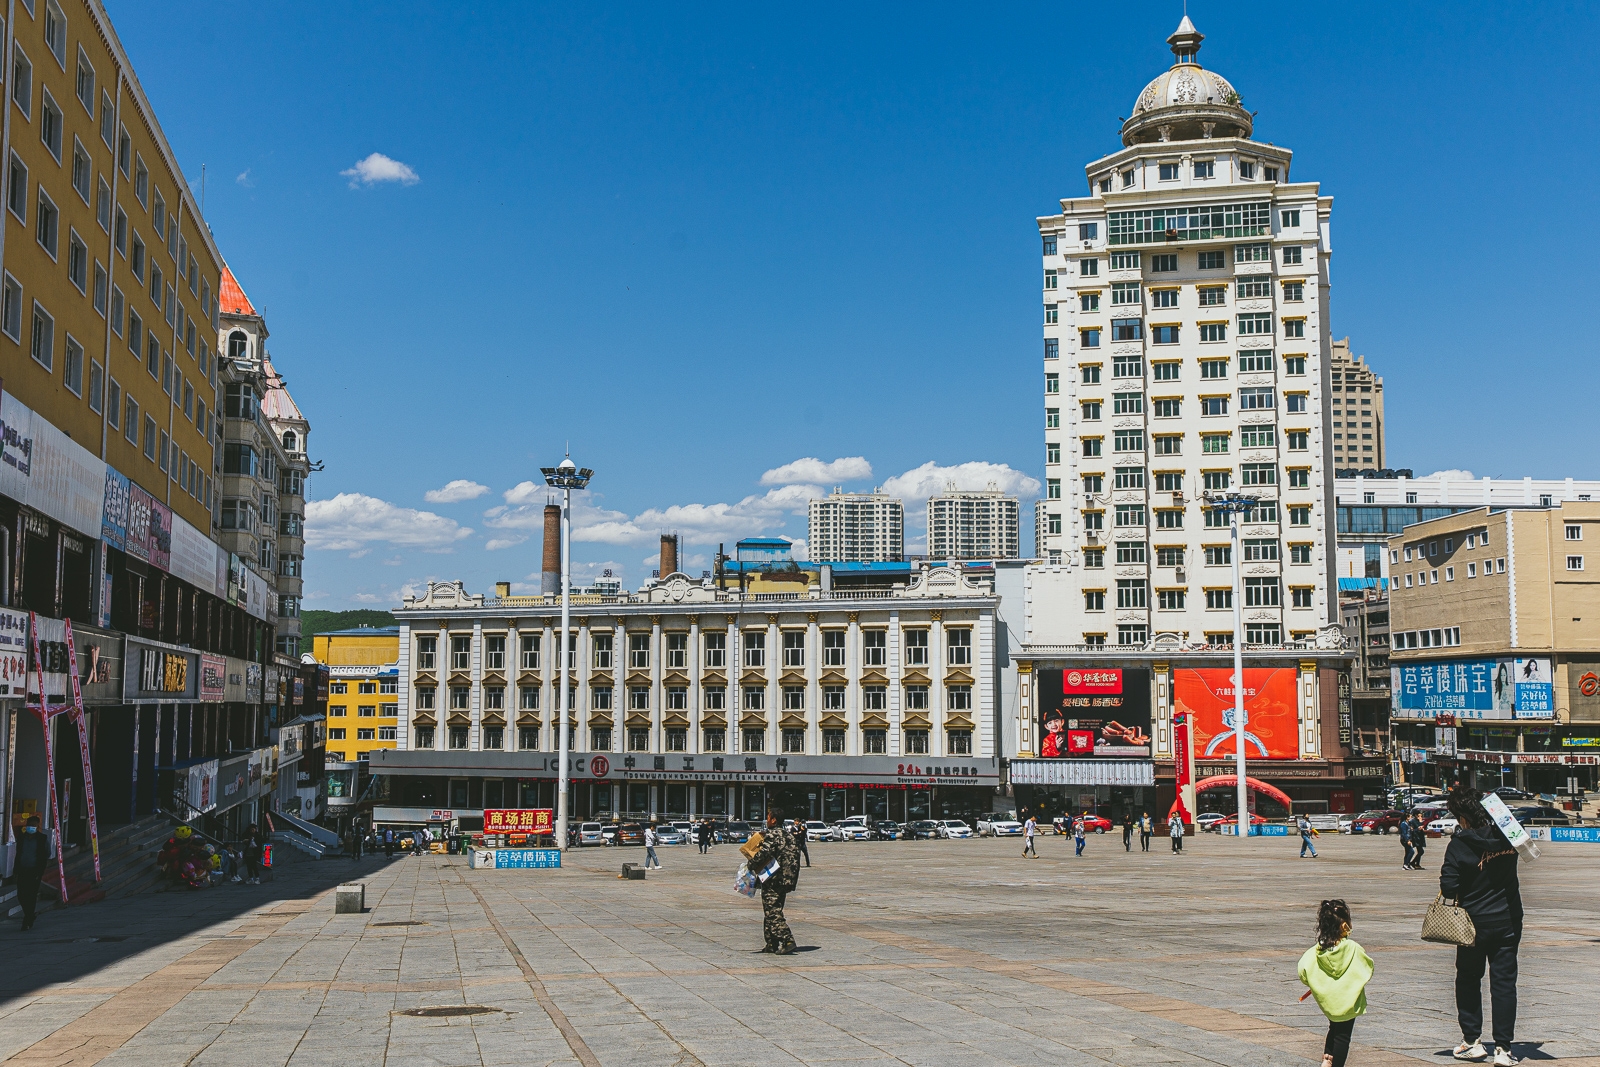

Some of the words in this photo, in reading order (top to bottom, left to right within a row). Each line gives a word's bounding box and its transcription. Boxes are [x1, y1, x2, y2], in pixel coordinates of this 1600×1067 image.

[142, 649, 163, 691] HLA
[1404, 662, 1487, 694] 荟萃楼珠宝
[1521, 691, 1547, 700] 买好钻
[1338, 671, 1350, 743] 六桂福珠宝
[1521, 701, 1547, 710] 荟萃楼
[624, 755, 788, 772] 中国工商银行
[897, 763, 921, 775] 24h
[1347, 766, 1383, 776] 六桂福珠宝
[490, 811, 550, 825] 商场招商
[497, 851, 559, 863] 荟萃楼珠宝
